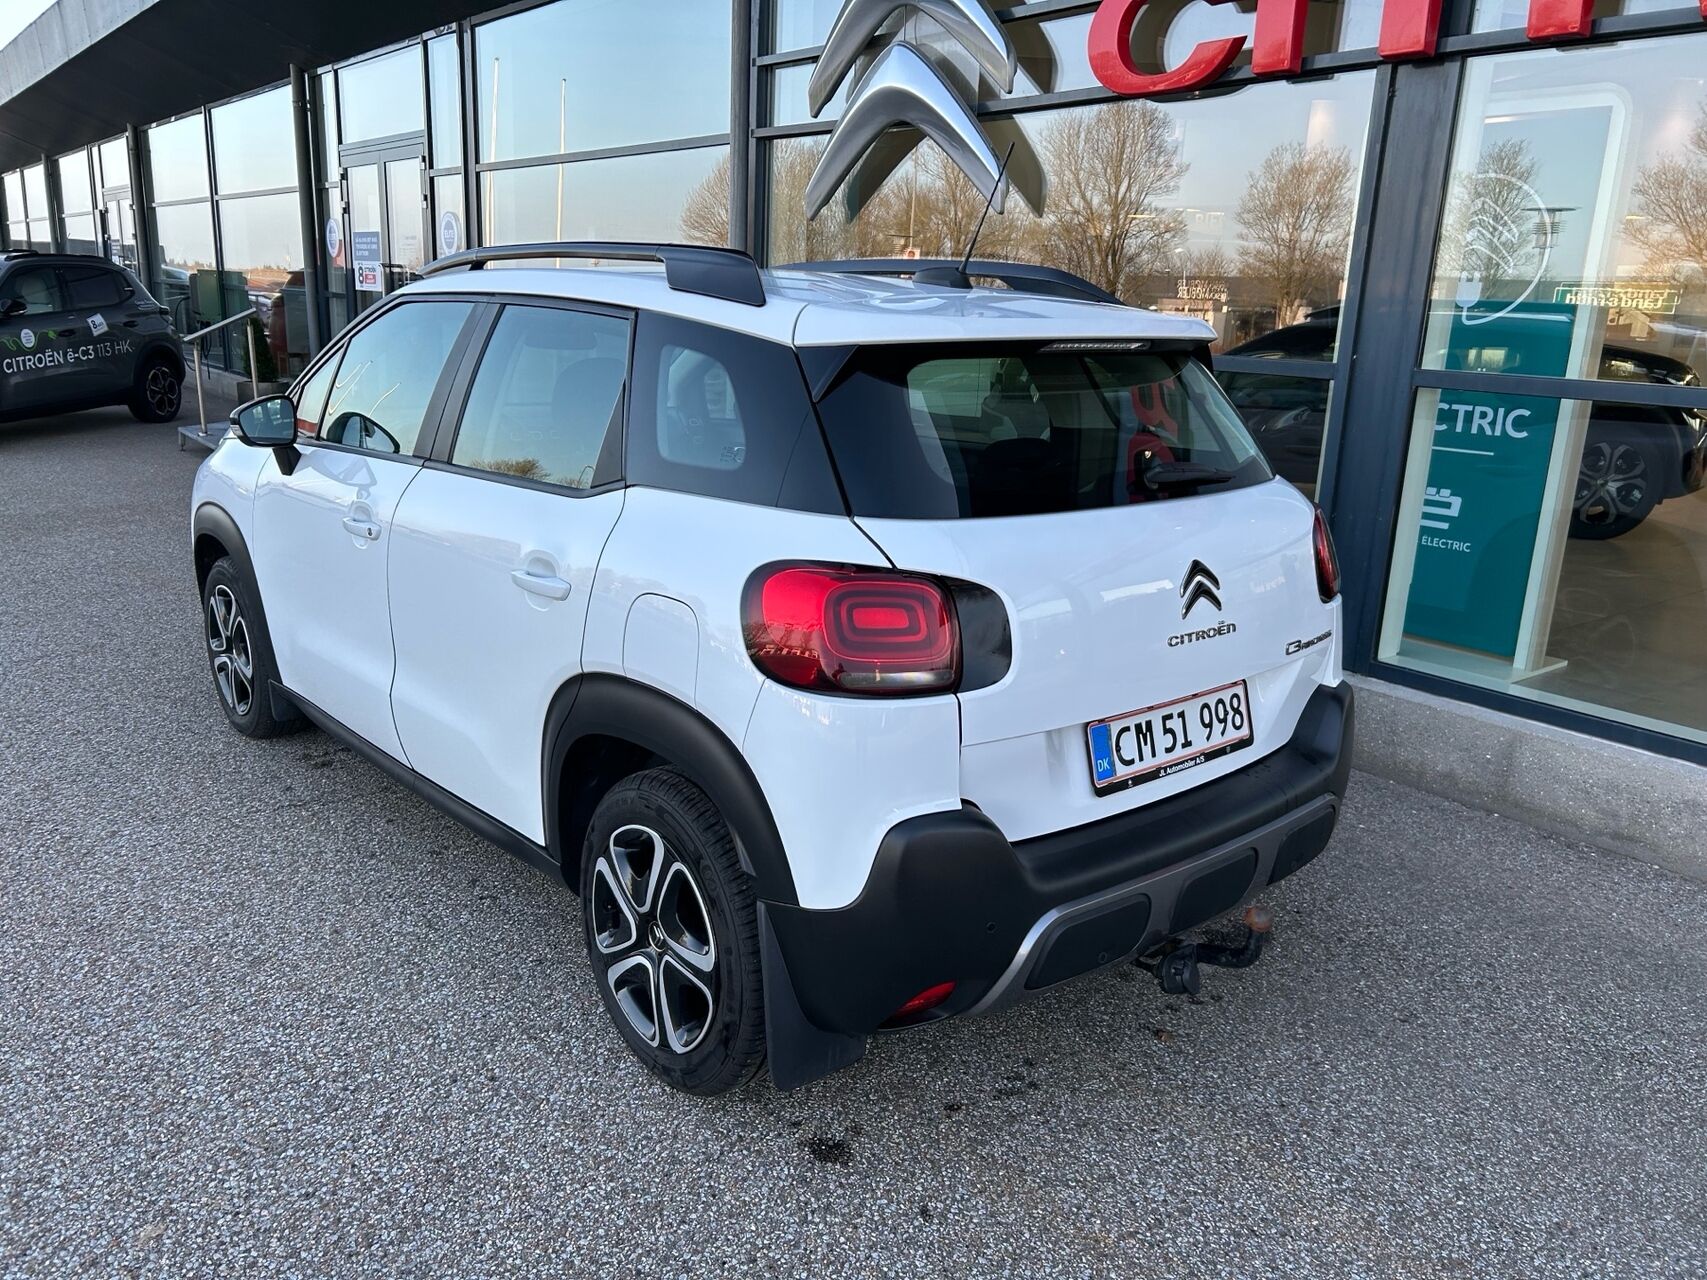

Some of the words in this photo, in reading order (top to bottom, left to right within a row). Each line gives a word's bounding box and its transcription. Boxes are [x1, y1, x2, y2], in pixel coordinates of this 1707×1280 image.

[90, 319, 98, 330] 8
[2, 348, 64, 374] CITROËN
[97, 342, 111, 358] 113
[1434, 402, 1532, 439] CTRIC
[1115, 719, 1157, 767] CM
[1161, 709, 1193, 754] 51
[1200, 692, 1245, 742] 998
[1097, 757, 1111, 773] DK
